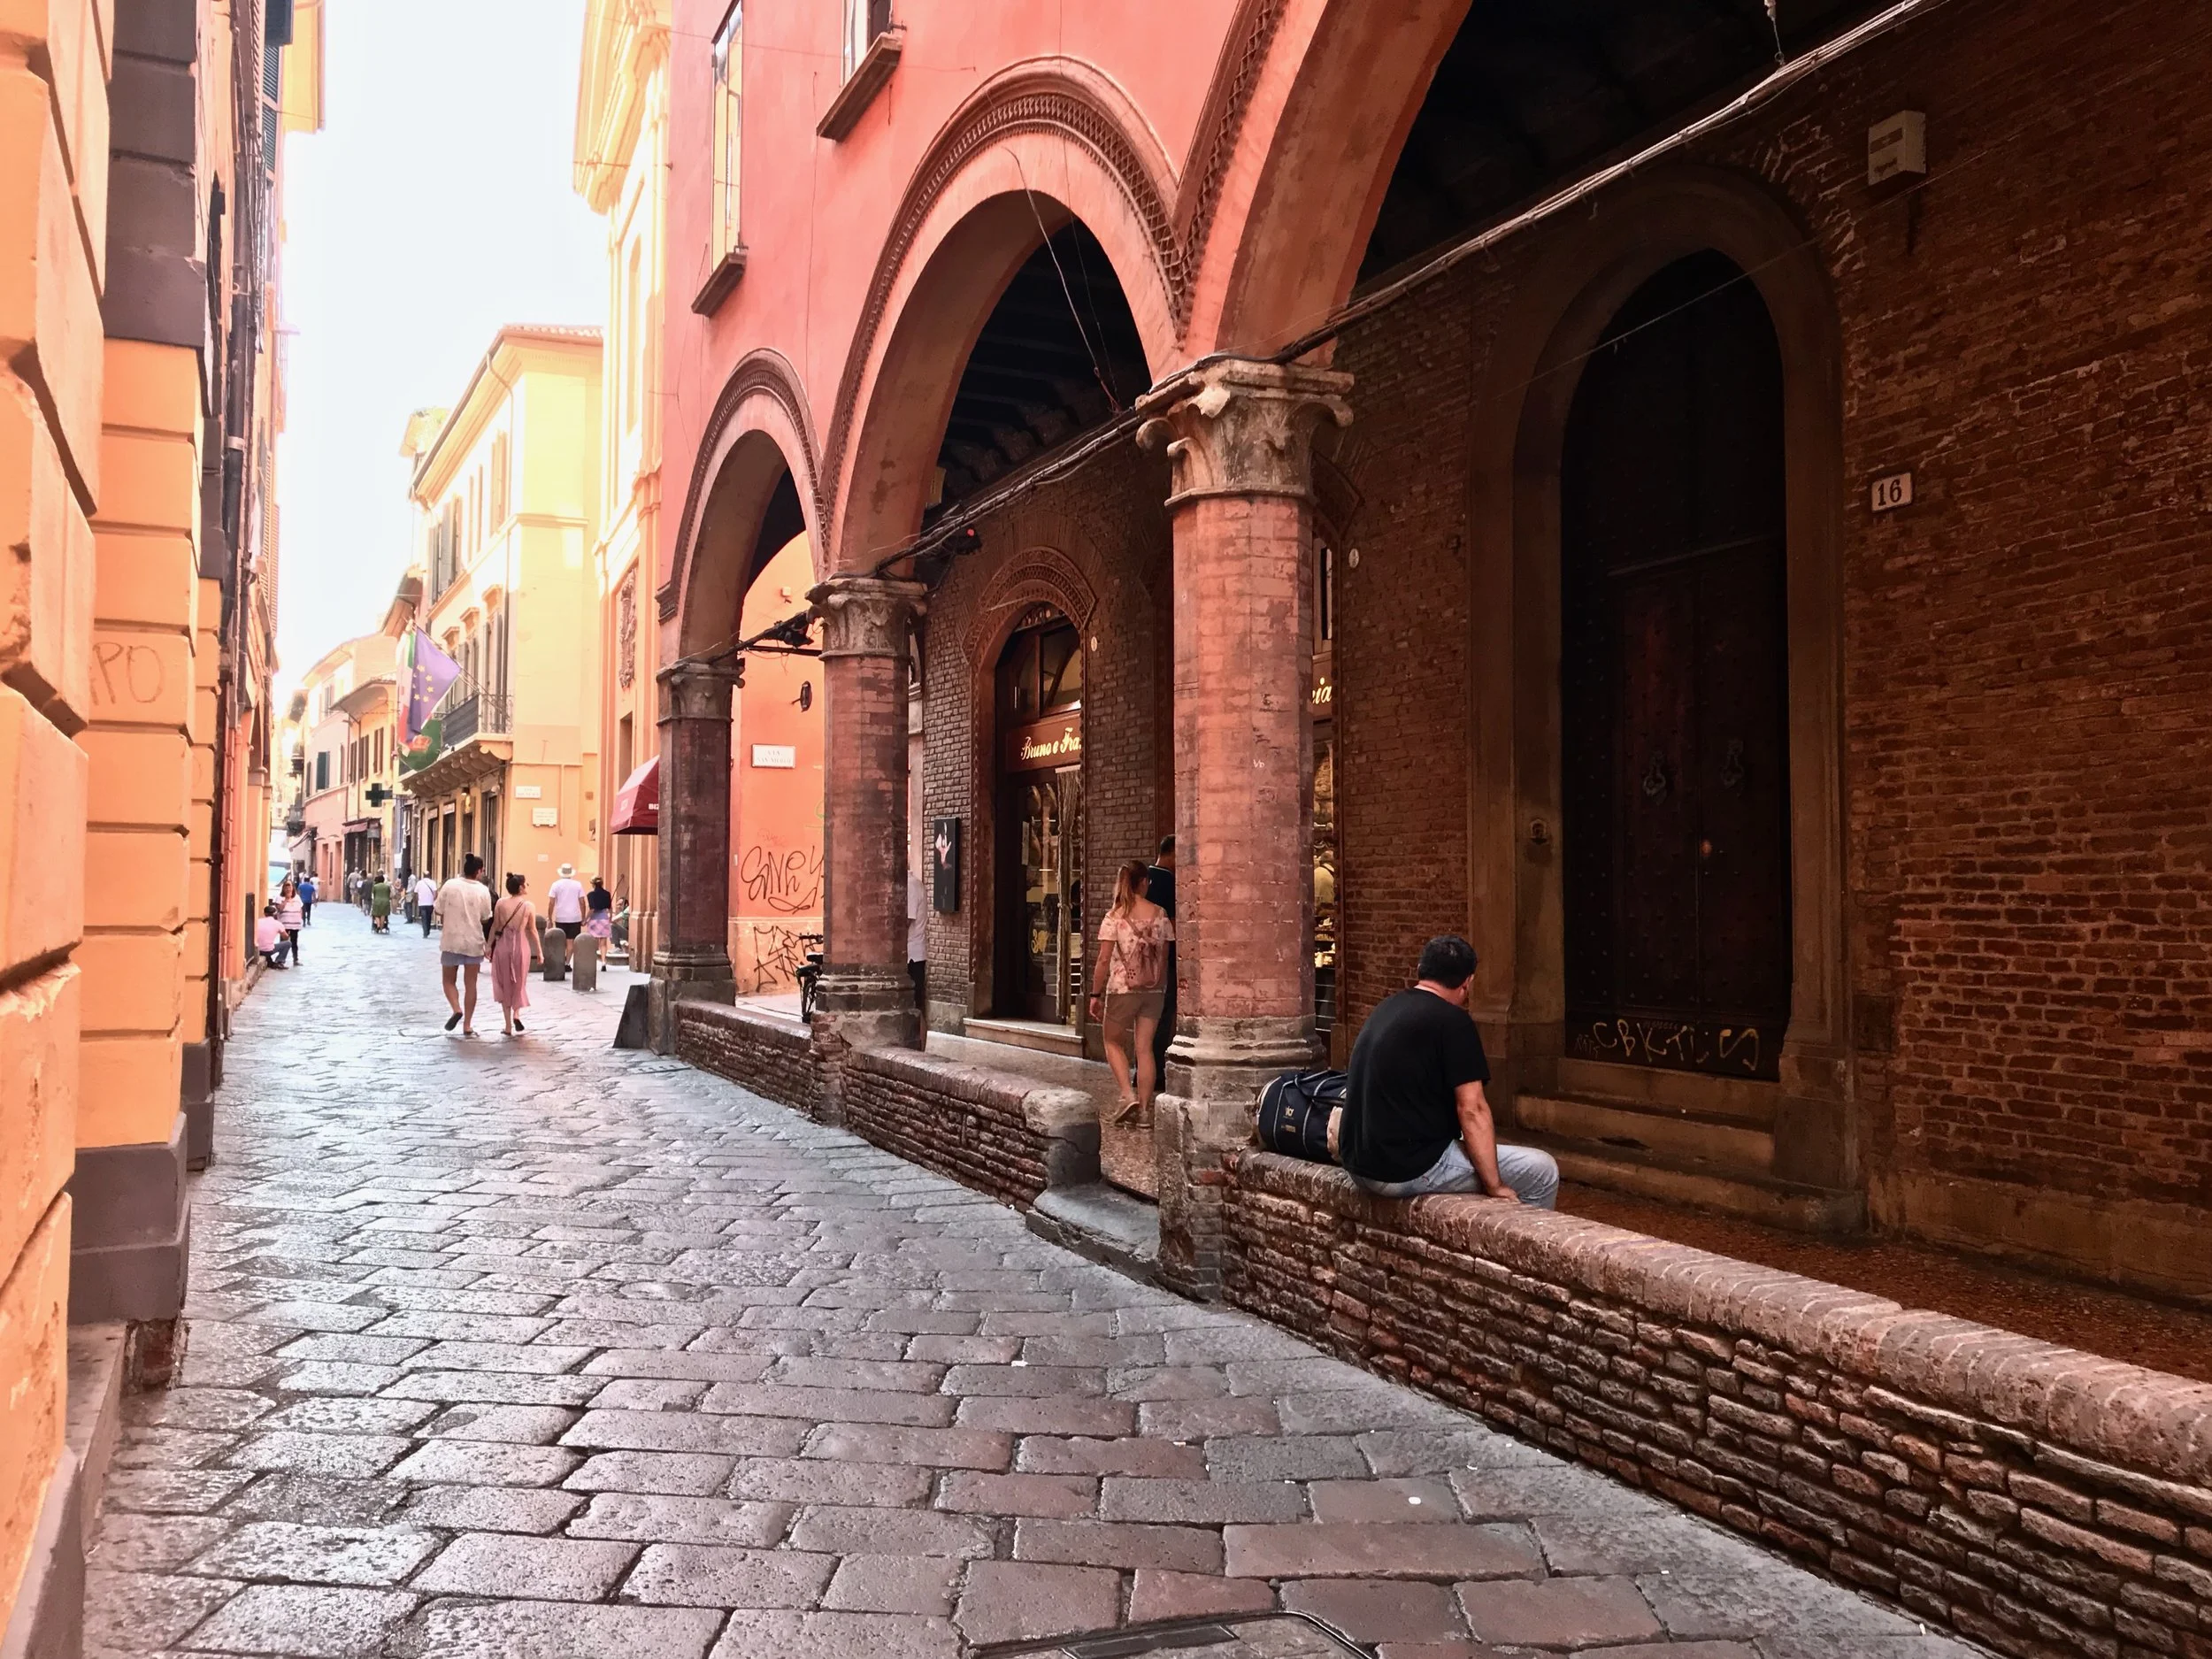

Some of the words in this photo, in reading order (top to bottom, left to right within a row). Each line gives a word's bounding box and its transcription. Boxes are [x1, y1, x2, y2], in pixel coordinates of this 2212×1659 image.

[1878, 479, 1902, 506] 16
[1020, 736, 1051, 760] Bruno
[1052, 741, 1059, 754] e
[1060, 726, 1081, 754] Fra
